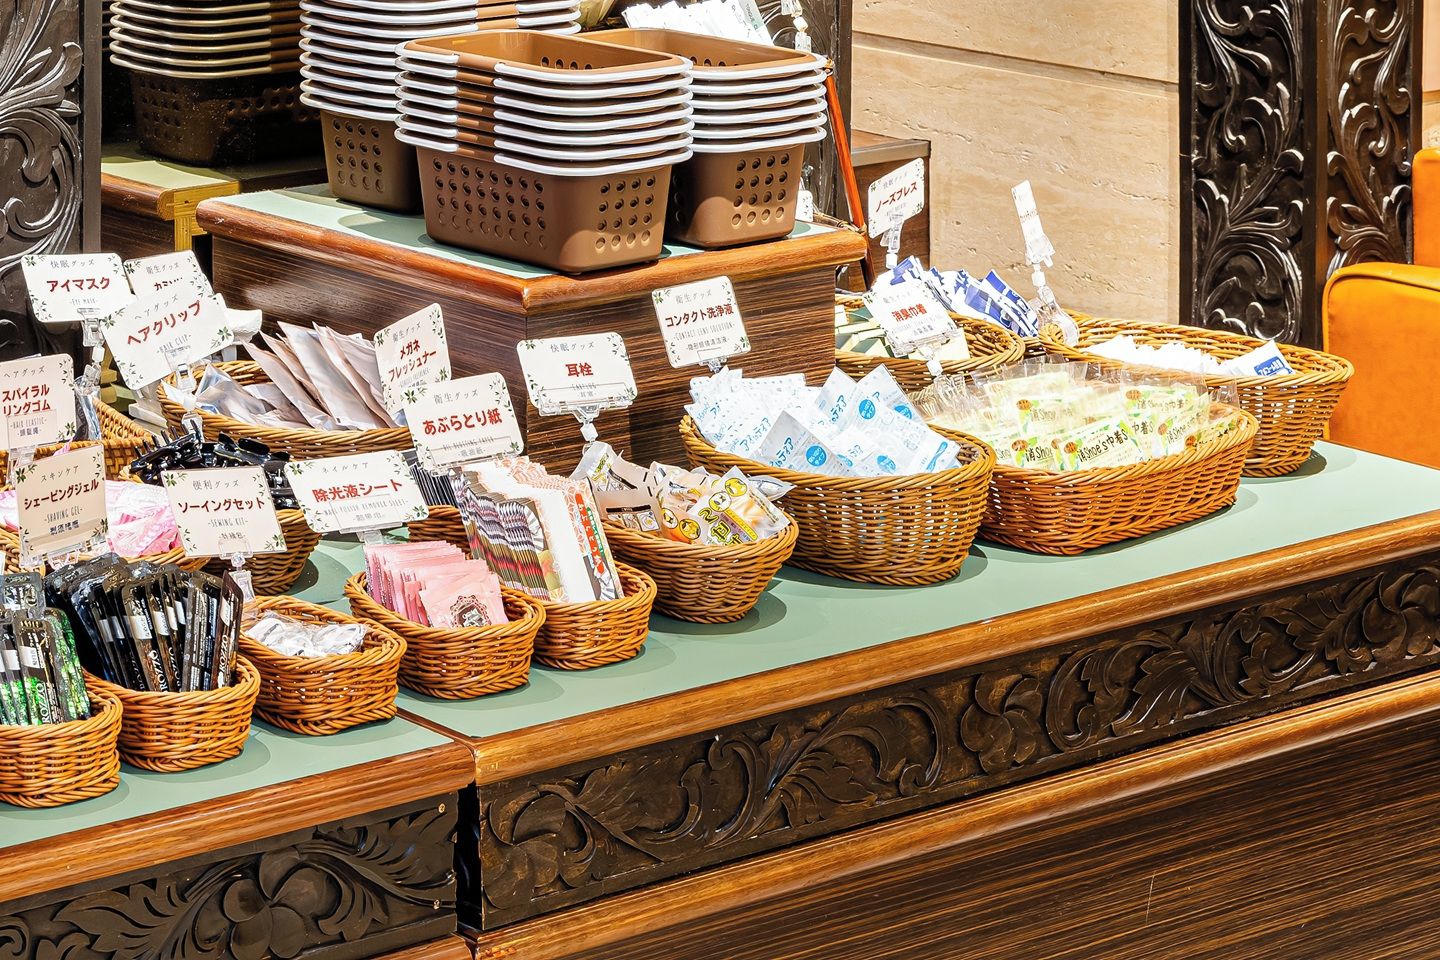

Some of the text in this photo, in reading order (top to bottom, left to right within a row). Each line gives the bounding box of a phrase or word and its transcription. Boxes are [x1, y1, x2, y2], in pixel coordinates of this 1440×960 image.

[45, 276, 111, 293] アイマスク
[127, 299, 201, 345] ヘアクリップ
[665, 303, 735, 328] コンタクト洗浄液
[891, 303, 927, 323] 消臭巾着
[399, 338, 421, 360] メガネ
[550, 340, 595, 353] 快眠グッズ
[3, 365, 45, 378] ヘアグッズ
[388, 350, 437, 383] フレッシュナー
[566, 362, 594, 378] 耳栓
[2, 383, 50, 403] スパイラル
[433, 388, 479, 405] 衛生グッズ
[3, 400, 51, 416] リングゴム
[422, 407, 503, 436] あぶらとり紙
[40, 464, 79, 483] スキンケア
[23, 478, 100, 511] シェービングジェル
[192, 479, 239, 491] 便利グッズ
[312, 478, 403, 503] 除光液シート
[177, 496, 265, 514] ソーイングセット
